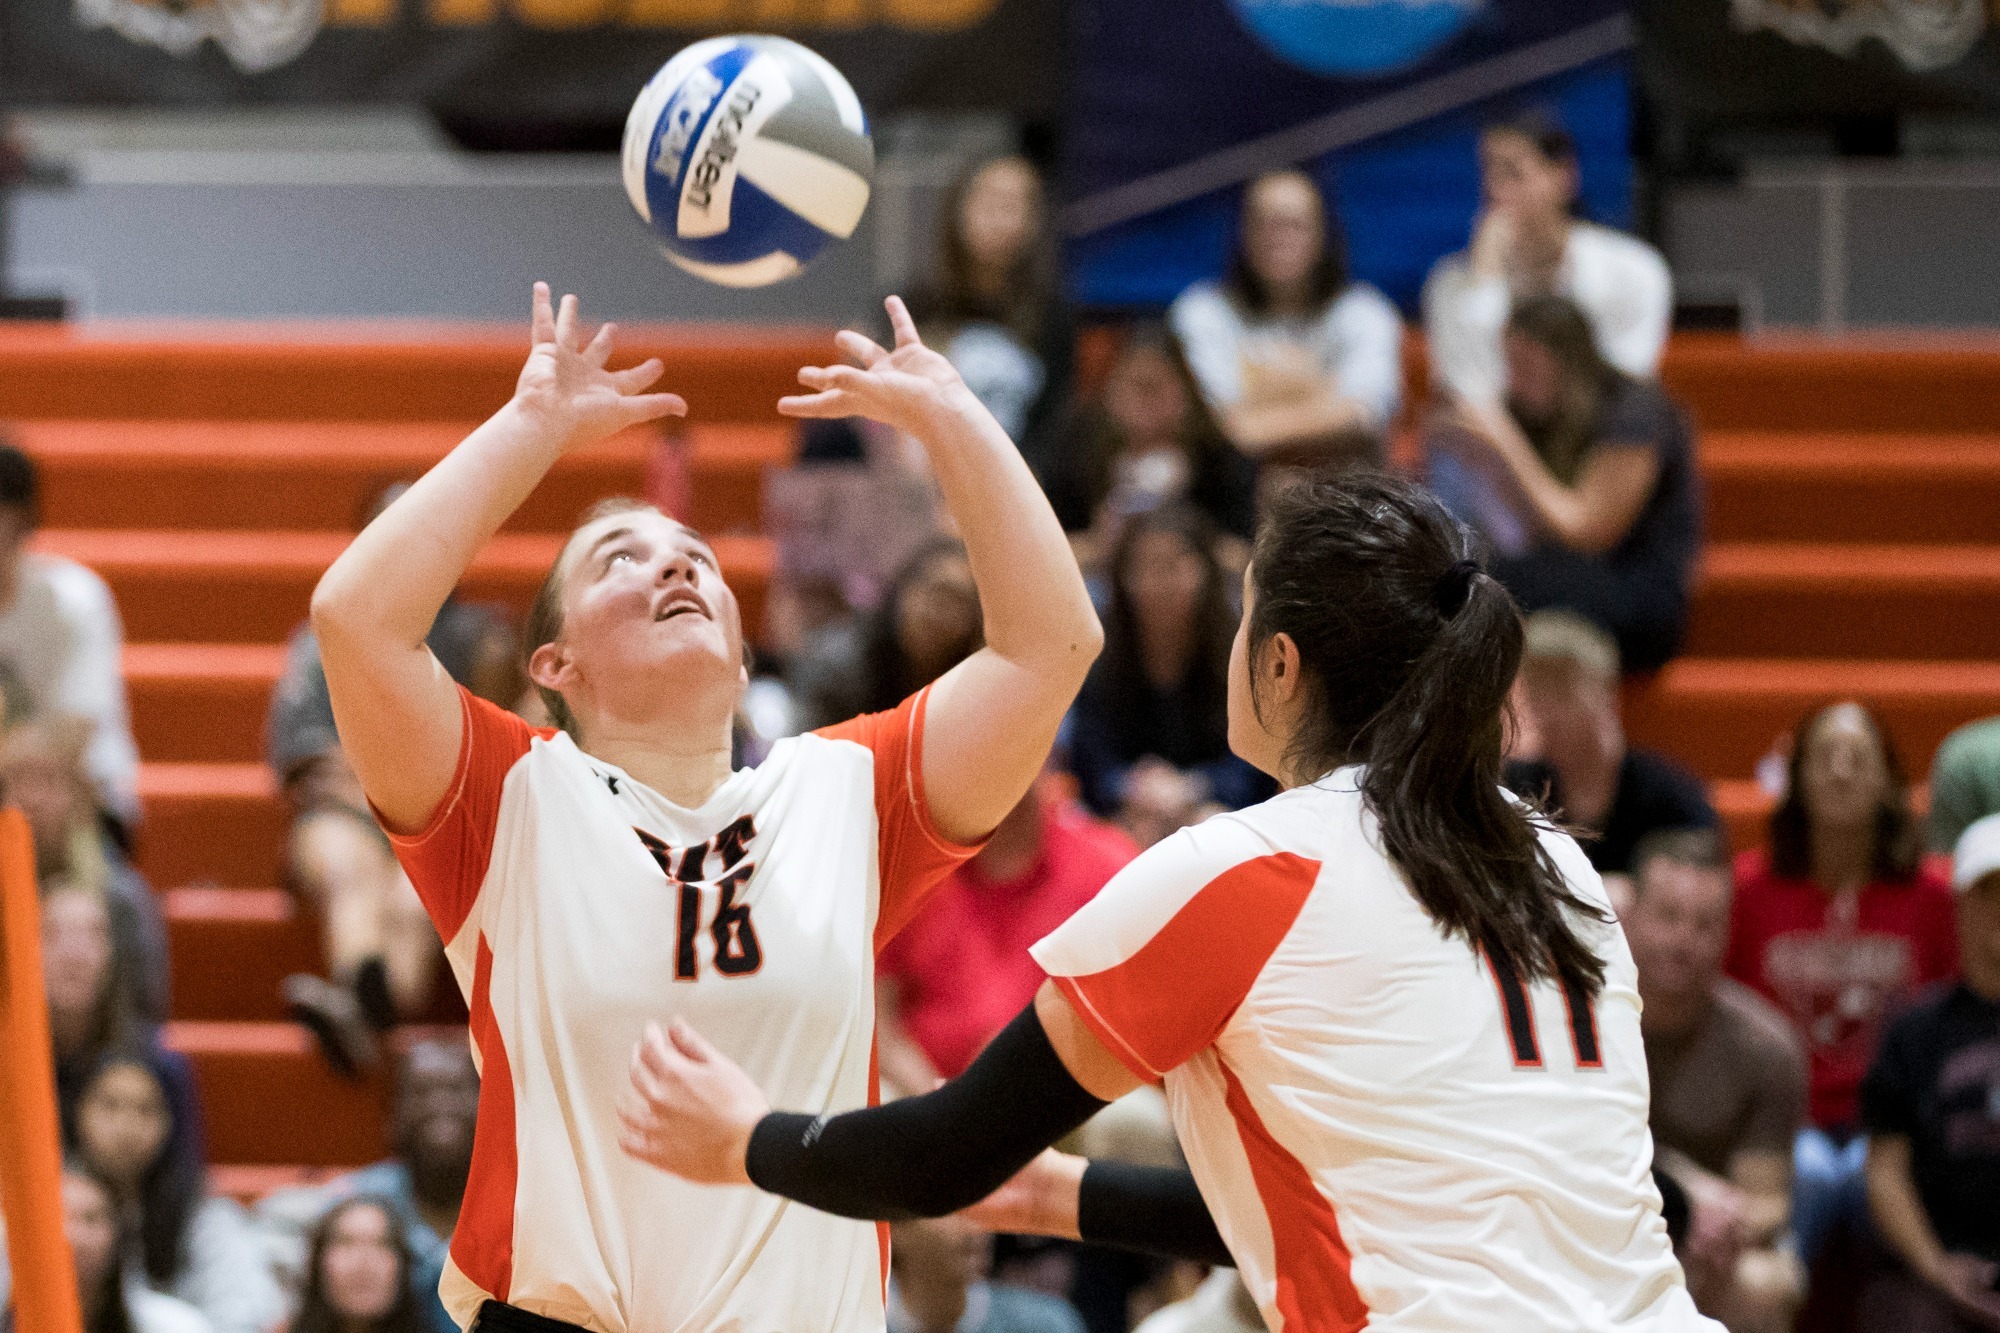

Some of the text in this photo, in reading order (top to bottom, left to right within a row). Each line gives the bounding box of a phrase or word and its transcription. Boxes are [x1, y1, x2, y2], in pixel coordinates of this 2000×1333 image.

[687, 80, 762, 210] molten
[672, 862, 765, 983] 16
[1477, 936, 1606, 1072] 11
